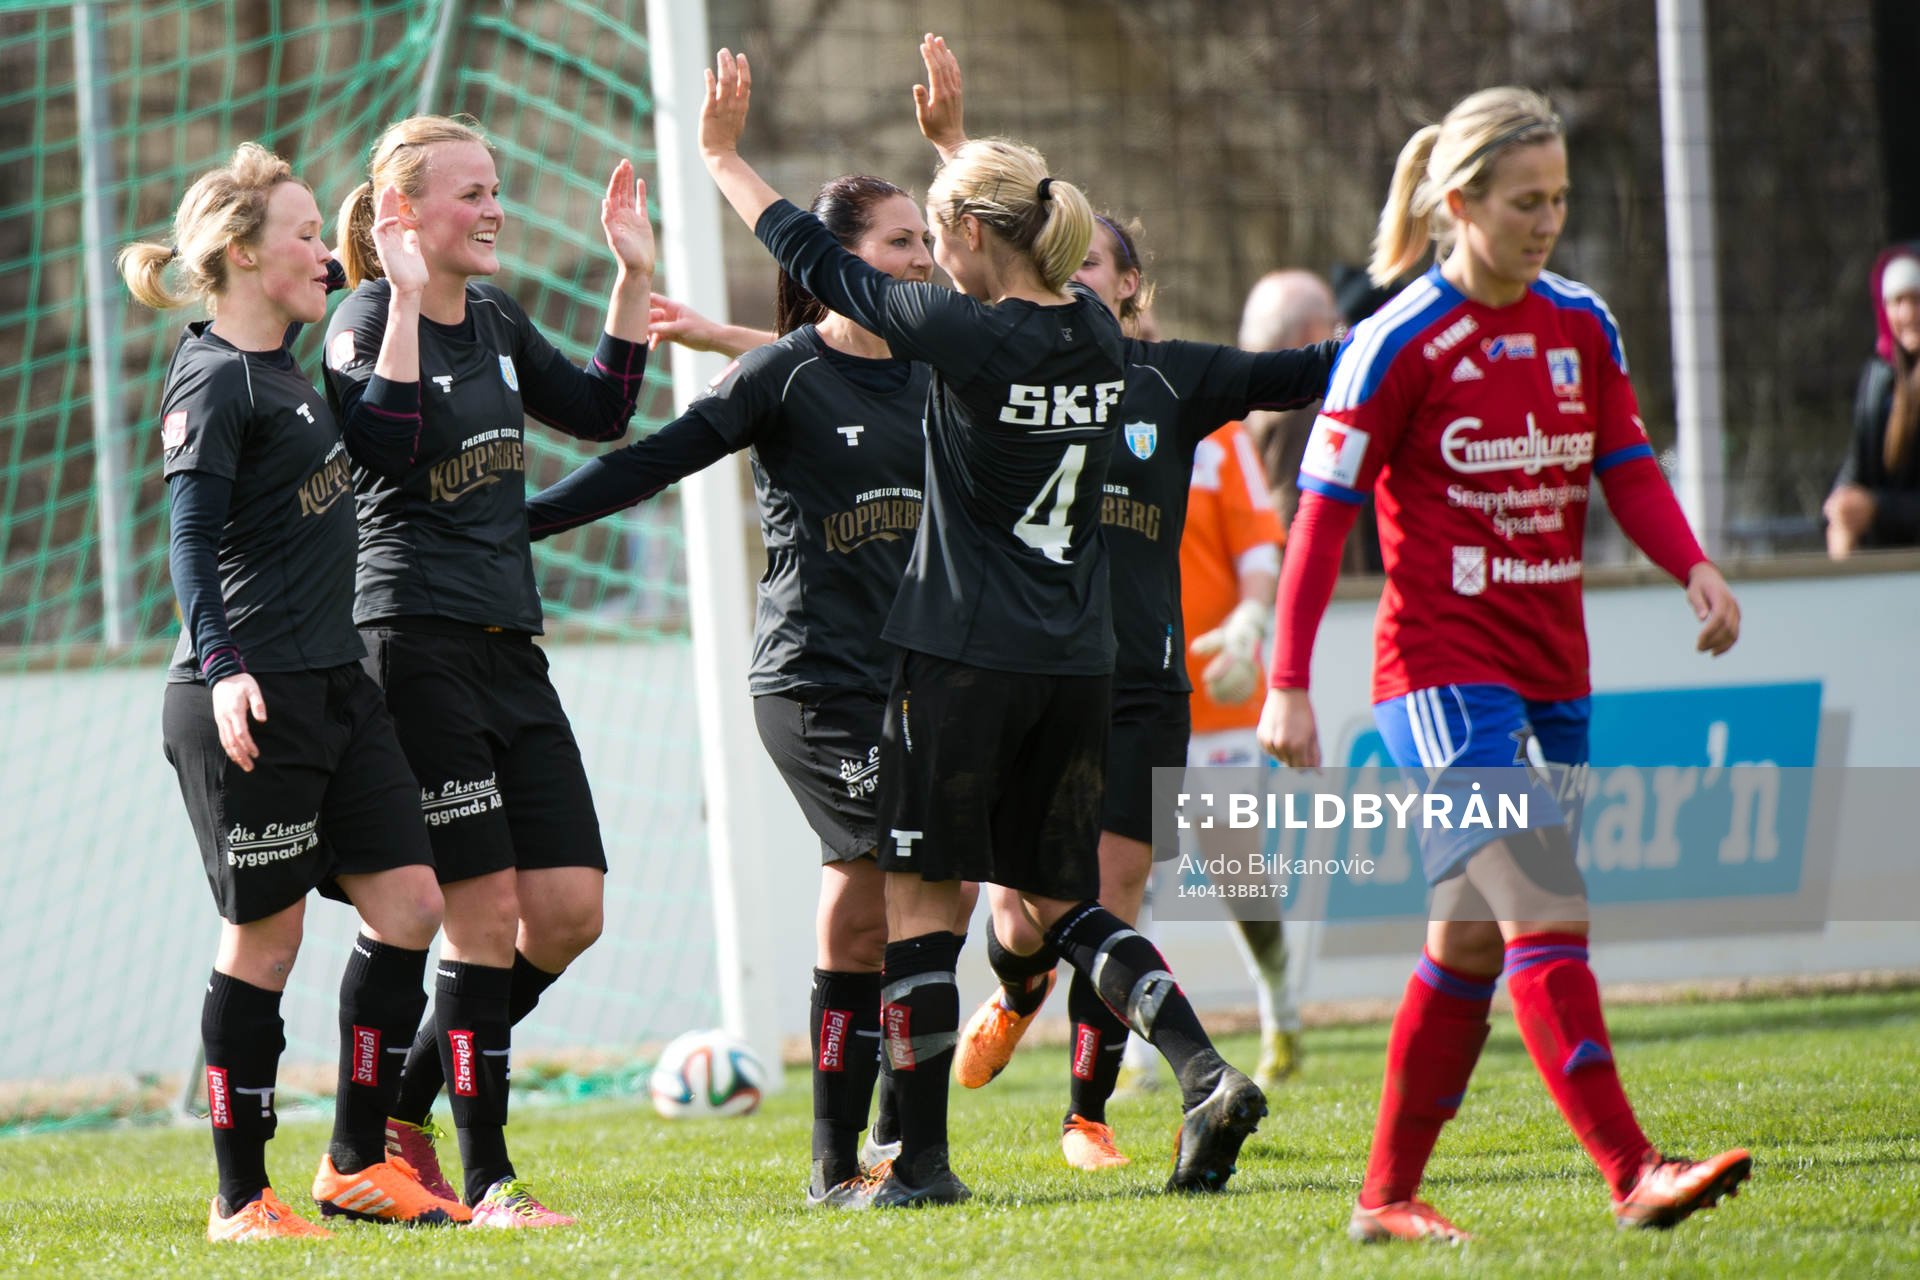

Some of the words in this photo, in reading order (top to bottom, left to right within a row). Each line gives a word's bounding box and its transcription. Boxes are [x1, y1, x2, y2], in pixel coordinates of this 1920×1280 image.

[998, 379, 1125, 426] SKF
[461, 429, 499, 451] PREMIUM
[856, 488, 901, 504] PREMIUM
[1013, 444, 1087, 565] 4
[441, 771, 496, 797] Ekstrand
[490, 793, 503, 810] AB
[227, 823, 256, 844] Åke
[227, 842, 303, 869] Byggnads
[306, 832, 318, 850] AB
[358, 1030, 375, 1083] Stavdal
[823, 1011, 845, 1067] Stavdal
[1075, 1028, 1096, 1077] Stavdal
[453, 1034, 472, 1092] Stavdal
[208, 1070, 228, 1126] Stavdal
